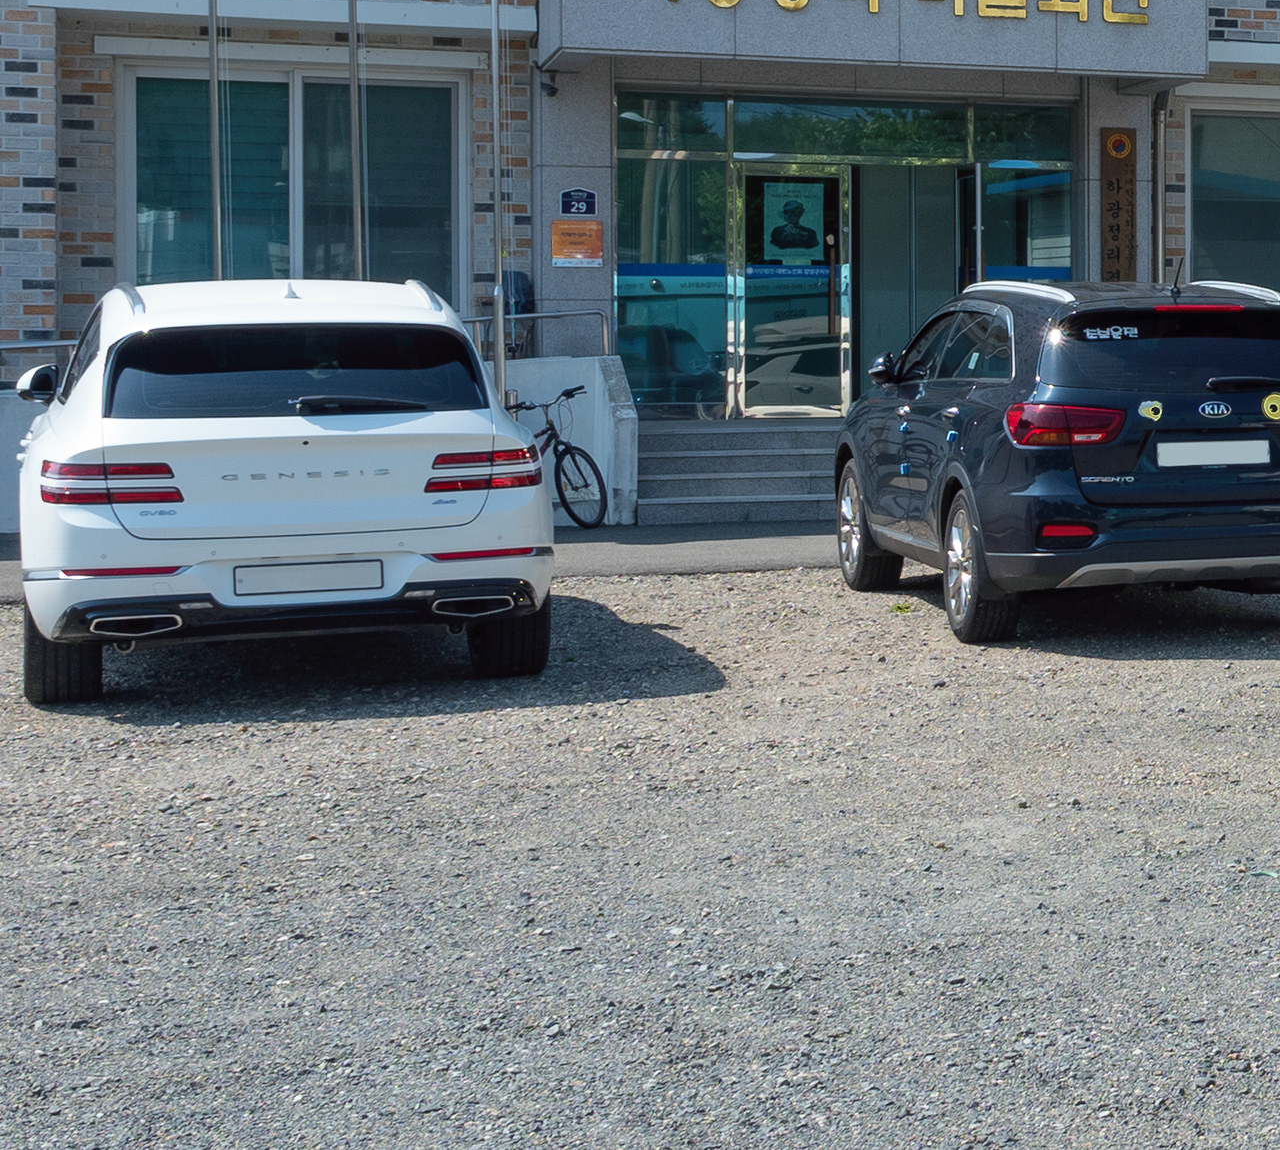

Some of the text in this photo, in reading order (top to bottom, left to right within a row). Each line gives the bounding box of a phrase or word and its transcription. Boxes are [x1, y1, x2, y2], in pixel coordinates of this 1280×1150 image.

[570, 201, 587, 213] 29
[1204, 404, 1228, 415] KIA
[220, 468, 391, 481] GENESIS
[139, 509, 177, 517] GV80
